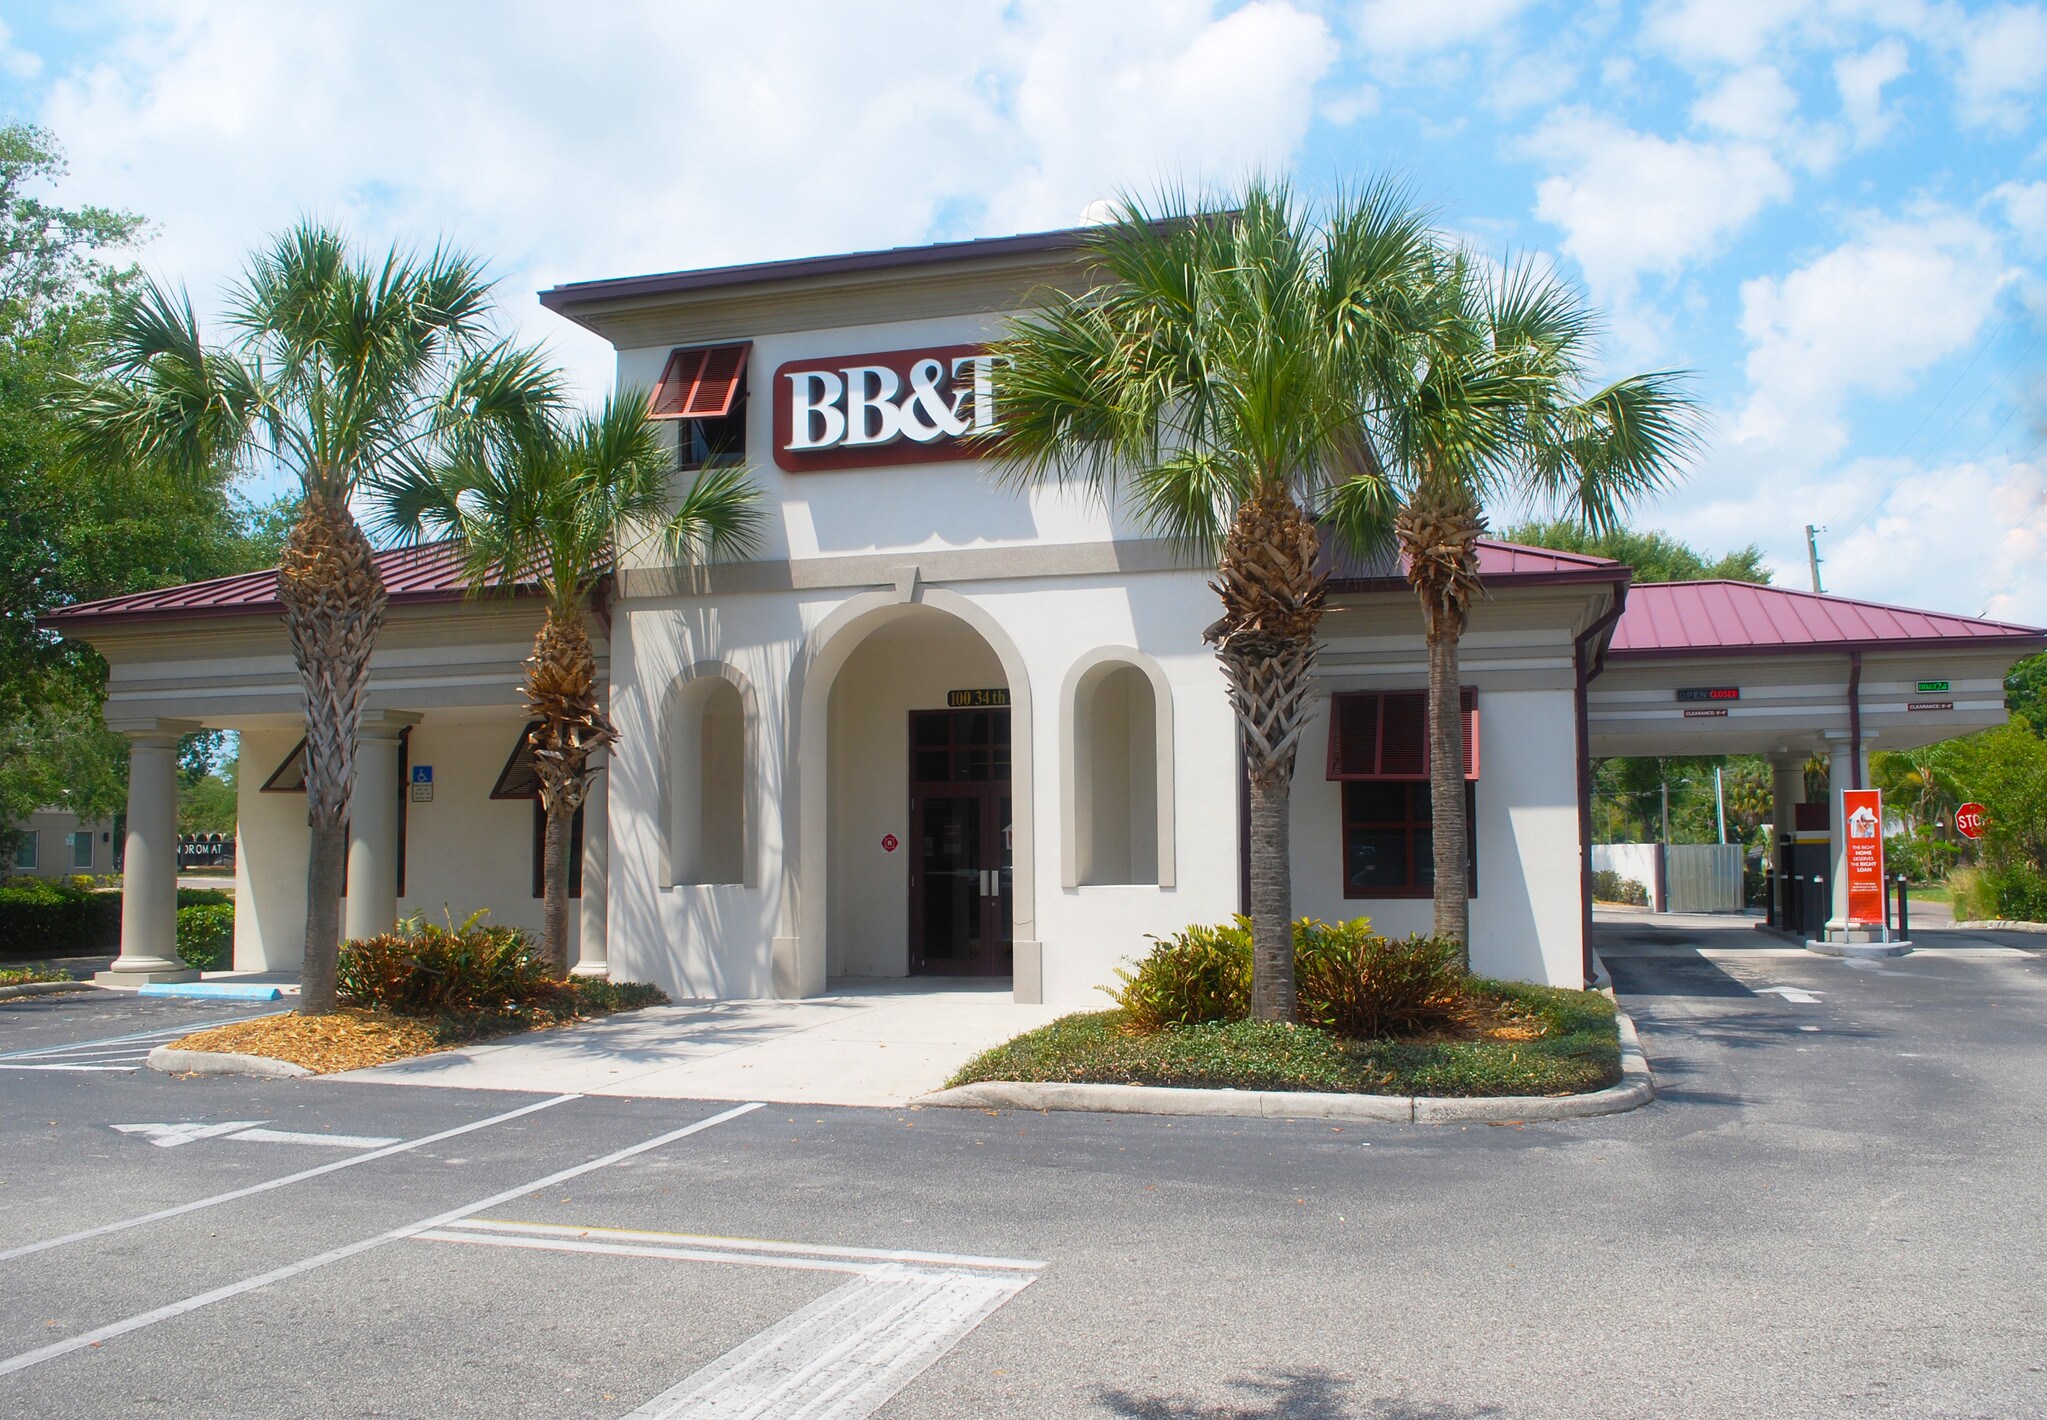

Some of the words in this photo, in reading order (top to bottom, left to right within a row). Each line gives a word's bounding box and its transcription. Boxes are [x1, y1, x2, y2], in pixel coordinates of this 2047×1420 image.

[783, 356, 1015, 449] BB&T
[951, 691, 971, 706] 100
[975, 690, 990, 705] 34
[992, 690, 1006, 704] th
[1680, 691, 1707, 699] OPEN
[1710, 689, 1739, 698] CLOSED
[1958, 814, 1985, 829] STO
